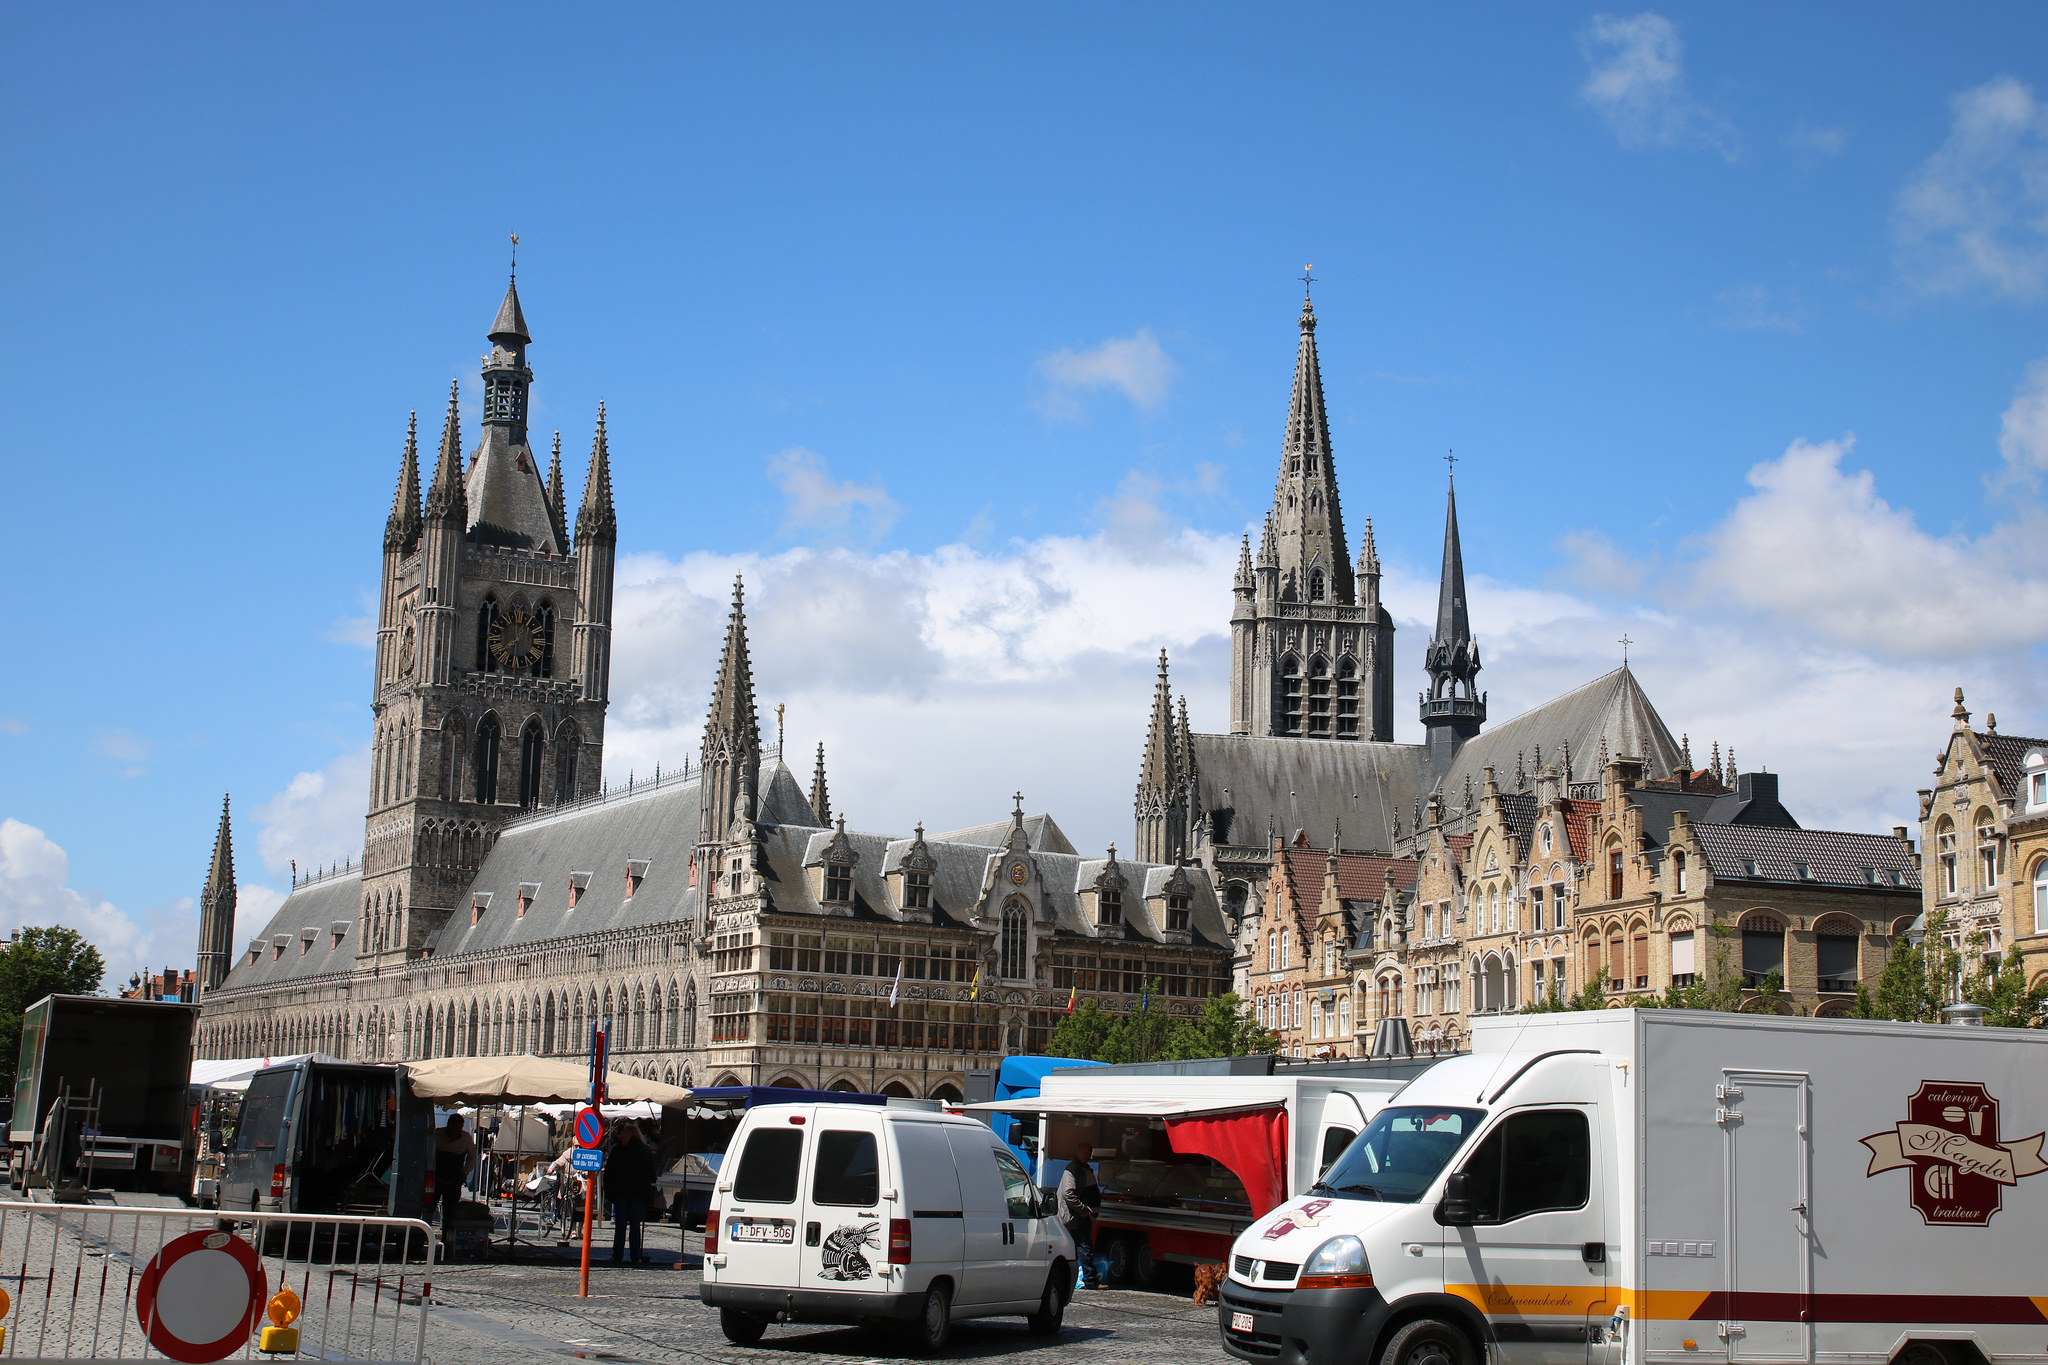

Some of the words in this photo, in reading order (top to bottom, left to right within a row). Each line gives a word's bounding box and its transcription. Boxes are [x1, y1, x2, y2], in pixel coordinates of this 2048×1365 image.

[1928, 1090, 1980, 1110] catering
[1908, 1130, 2008, 1178] Magda
[1932, 1205, 1981, 1219] traiteur
[739, 1226, 791, 1238] 1-DFV-506
